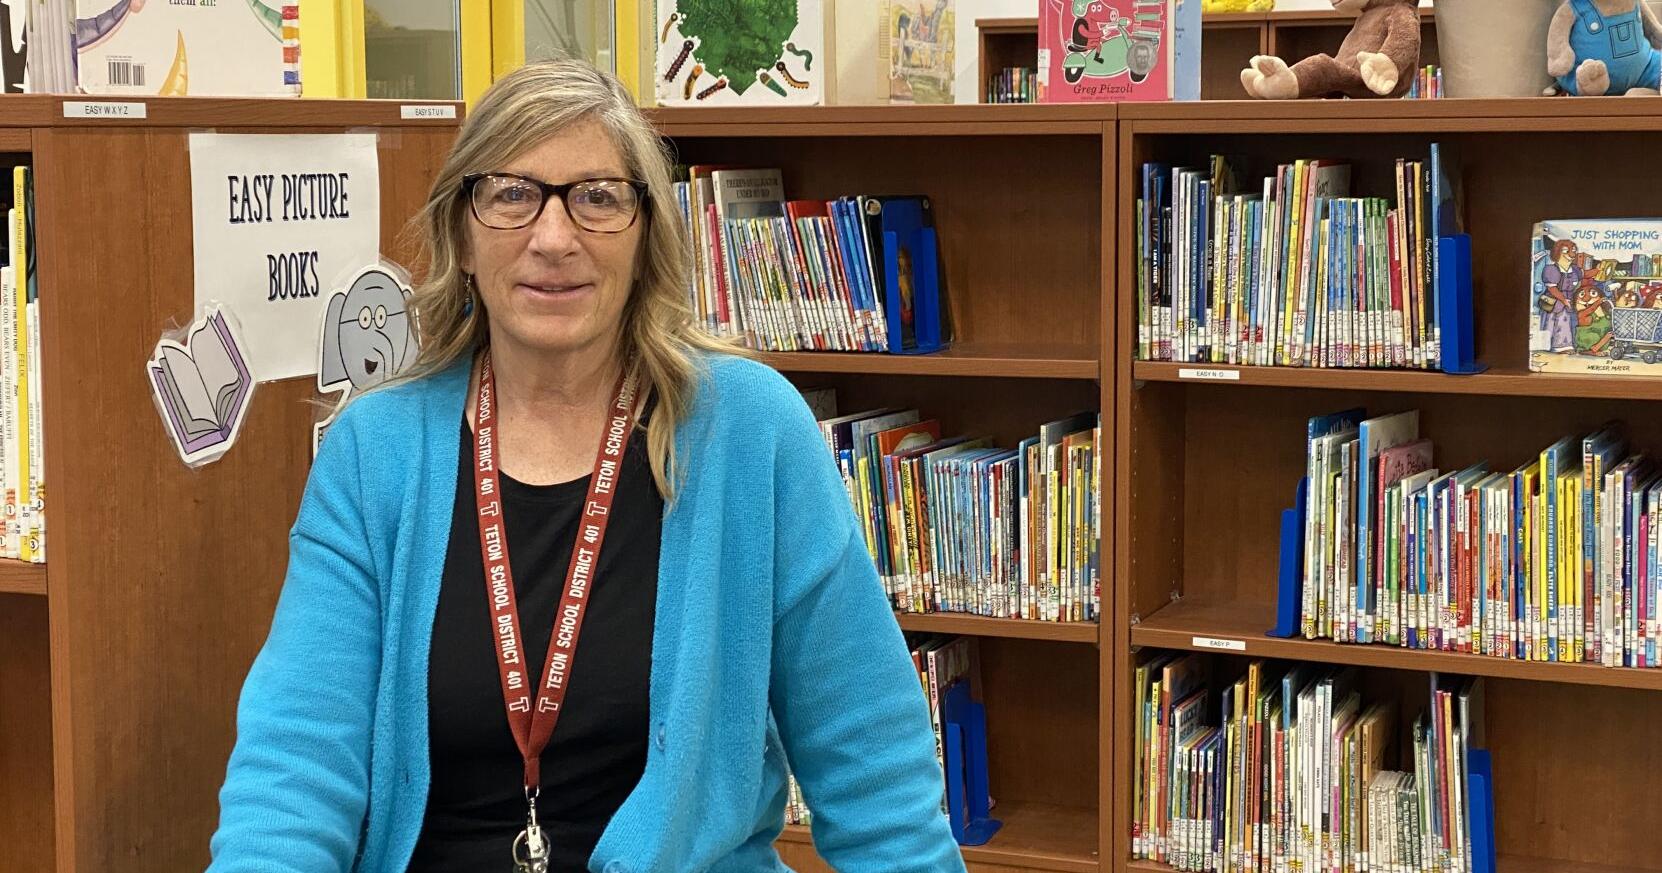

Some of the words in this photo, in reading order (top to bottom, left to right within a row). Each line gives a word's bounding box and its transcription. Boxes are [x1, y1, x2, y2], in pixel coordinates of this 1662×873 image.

[1074, 84, 1096, 96] Greg
[1100, 83, 1133, 94] Pizzoli
[84, 106, 102, 114] EASY
[104, 106, 110, 114] W
[112, 106, 117, 114] X
[118, 106, 122, 114] Y
[124, 106, 128, 114] Z
[228, 174, 274, 224] EASY
[281, 172, 350, 221] PICTURE
[1571, 230, 1599, 239] JUST
[1605, 230, 1659, 240] SHOPPING
[1593, 242, 1615, 250] WITH
[267, 250, 320, 301] BOOKS
[479, 383, 490, 424] SCHOOL
[479, 426, 493, 472] DISTRICT
[605, 415, 627, 456] SCHOOL
[480, 478, 494, 495] 401
[595, 460, 616, 494] TETON
[485, 524, 502, 561] TETON
[584, 524, 600, 544] 401
[490, 565, 510, 611] SCHOOL
[569, 548, 594, 598] DISTRICT
[498, 614, 519, 664] DISTRICT
[557, 603, 580, 649] SCHOOL
[507, 671, 522, 689] 401
[547, 653, 568, 689] TETON
